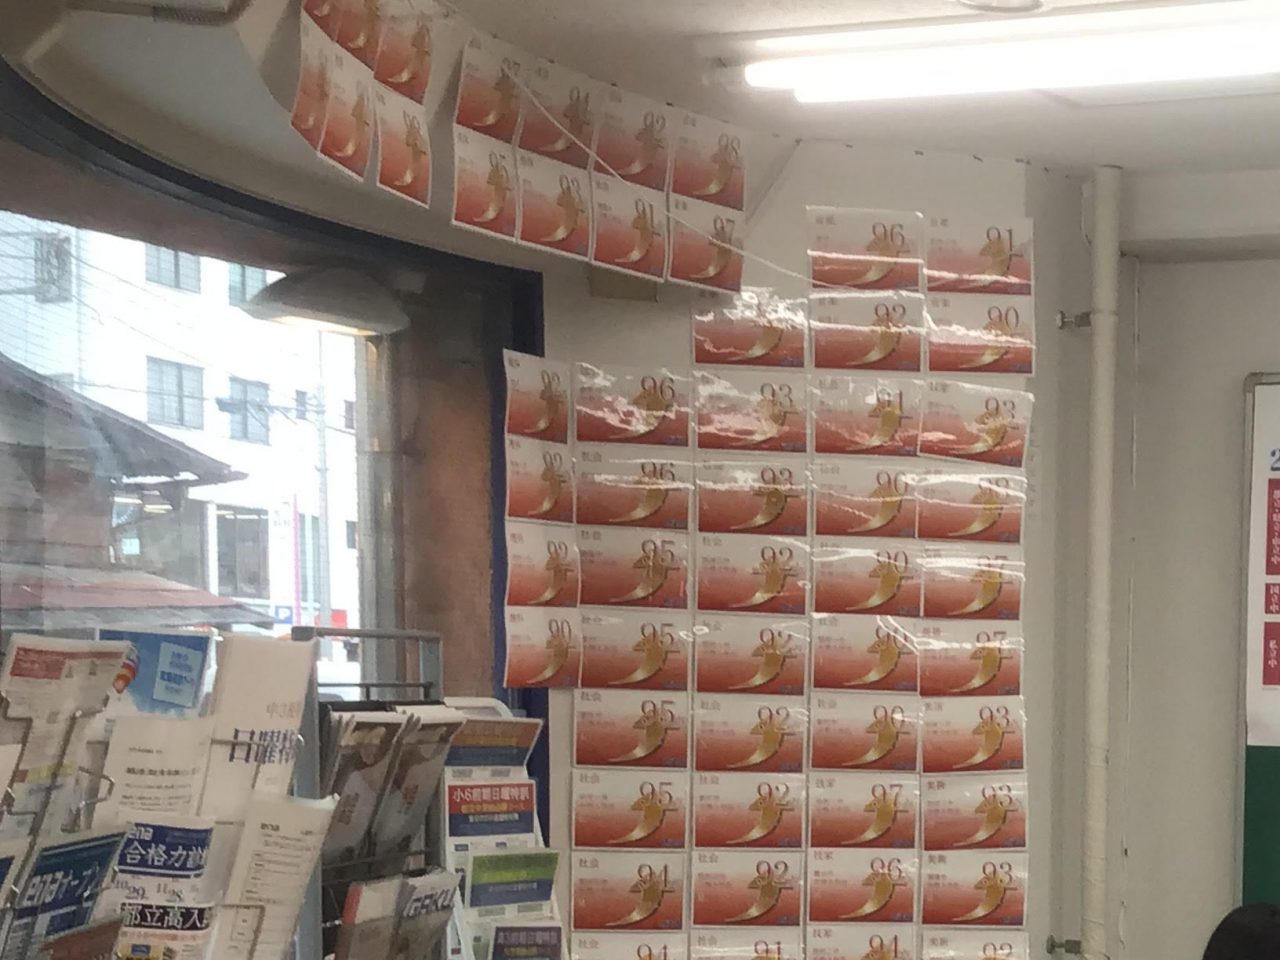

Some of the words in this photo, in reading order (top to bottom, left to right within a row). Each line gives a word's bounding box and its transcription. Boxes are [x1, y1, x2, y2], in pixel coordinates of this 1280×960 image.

[641, 700, 675, 723] 95
[640, 781, 673, 804] 95
[872, 783, 903, 808] 97
[756, 860, 788, 886] 92
[982, 862, 1013, 885] 93
